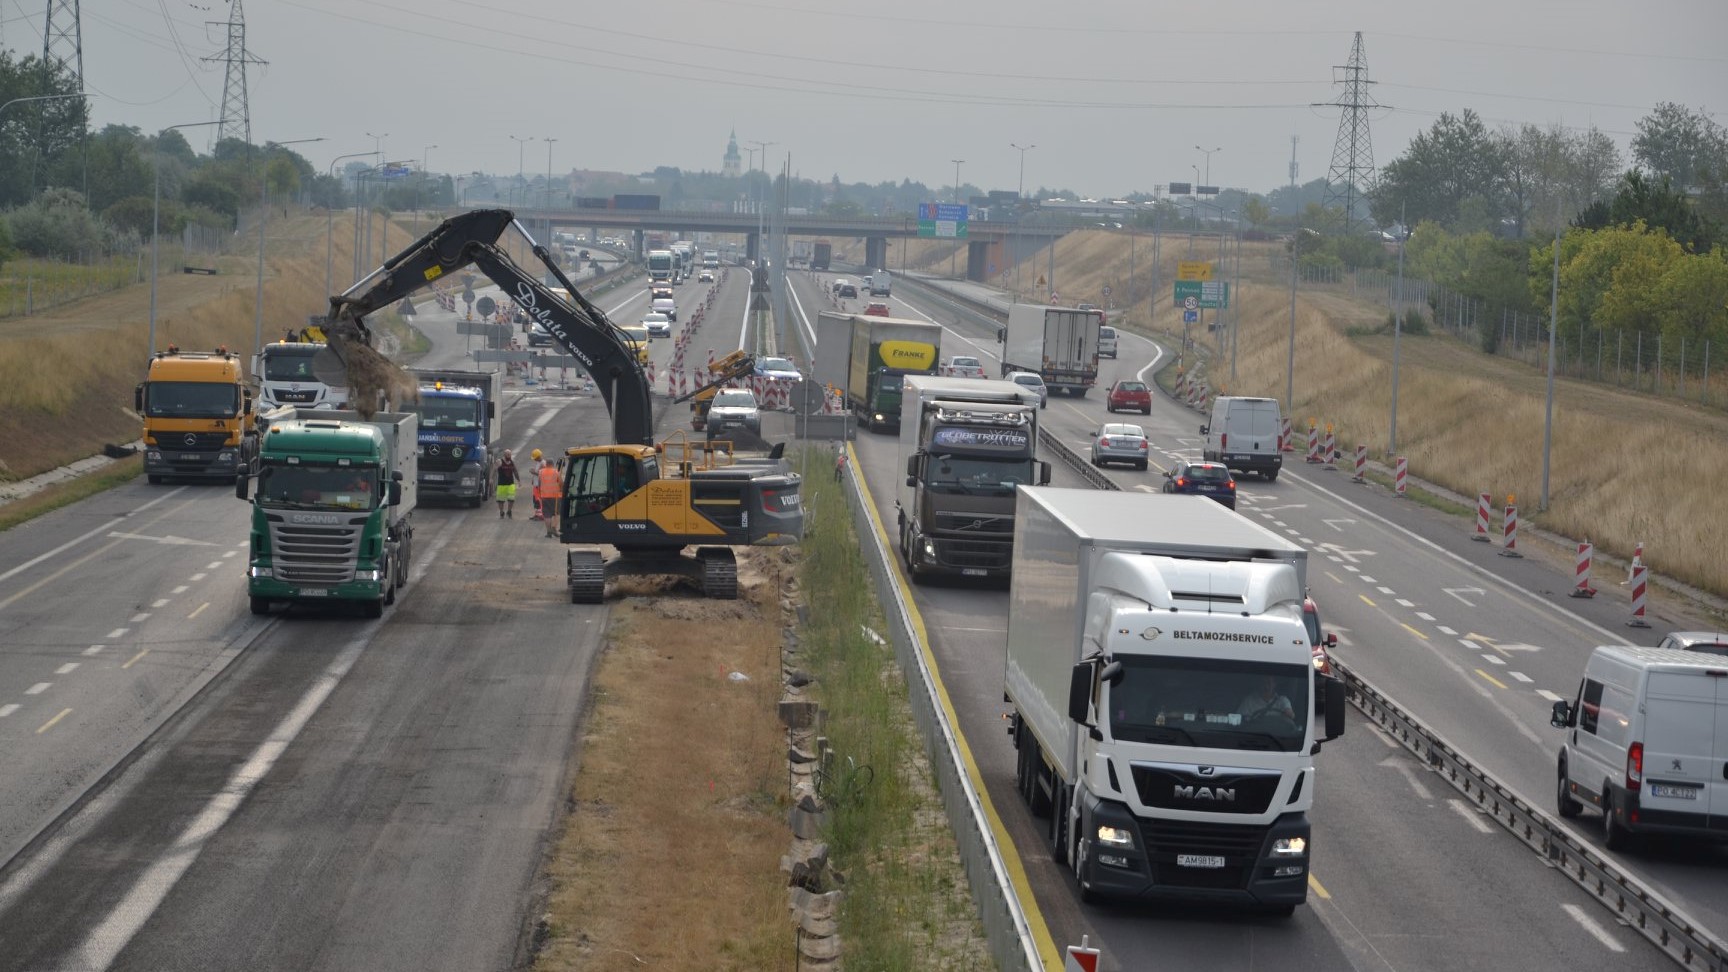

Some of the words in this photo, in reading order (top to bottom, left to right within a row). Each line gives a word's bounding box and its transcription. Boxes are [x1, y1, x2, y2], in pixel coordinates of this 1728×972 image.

[1186, 299, 1197, 307] 50
[513, 281, 568, 340] Dolata
[568, 341, 593, 366] VOLVO
[892, 349, 926, 359] FRANKE
[941, 431, 1026, 443] GLOBETROTTER
[293, 514, 339, 524] SCANIA
[1173, 630, 1274, 645] BELTAMOZHSERVICE
[1174, 784, 1236, 802] MAN
